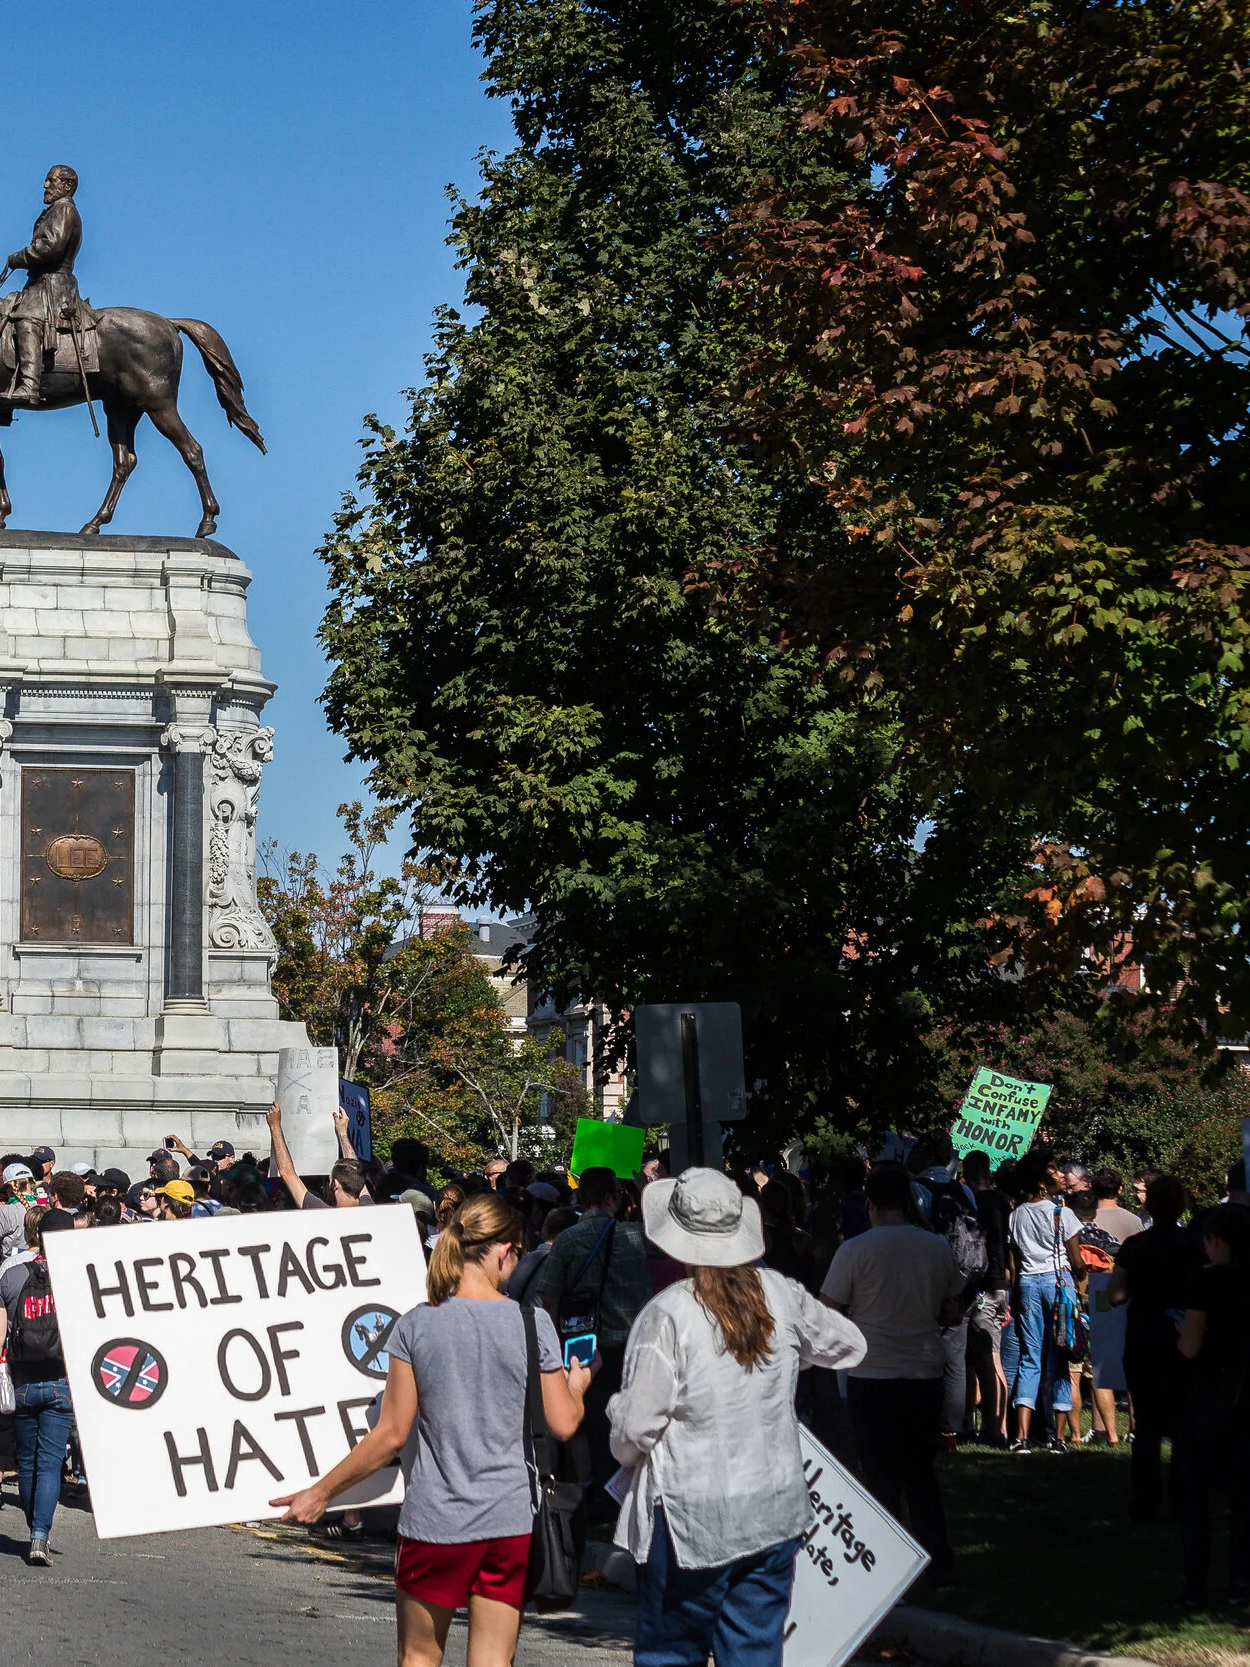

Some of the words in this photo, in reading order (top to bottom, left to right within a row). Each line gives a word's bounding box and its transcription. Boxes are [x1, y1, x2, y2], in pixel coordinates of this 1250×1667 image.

[56, 846, 100, 868] LEE
[978, 1084, 1039, 1109] Confuse
[990, 1074, 1037, 1094] Don't
[968, 1095, 1041, 1125] INFAMY
[981, 1116, 1010, 1130] with
[956, 1119, 1024, 1155] HONOR
[86, 1233, 382, 1318] HERITAGE
[217, 1320, 304, 1401] OF
[163, 1396, 402, 1497] HATE
